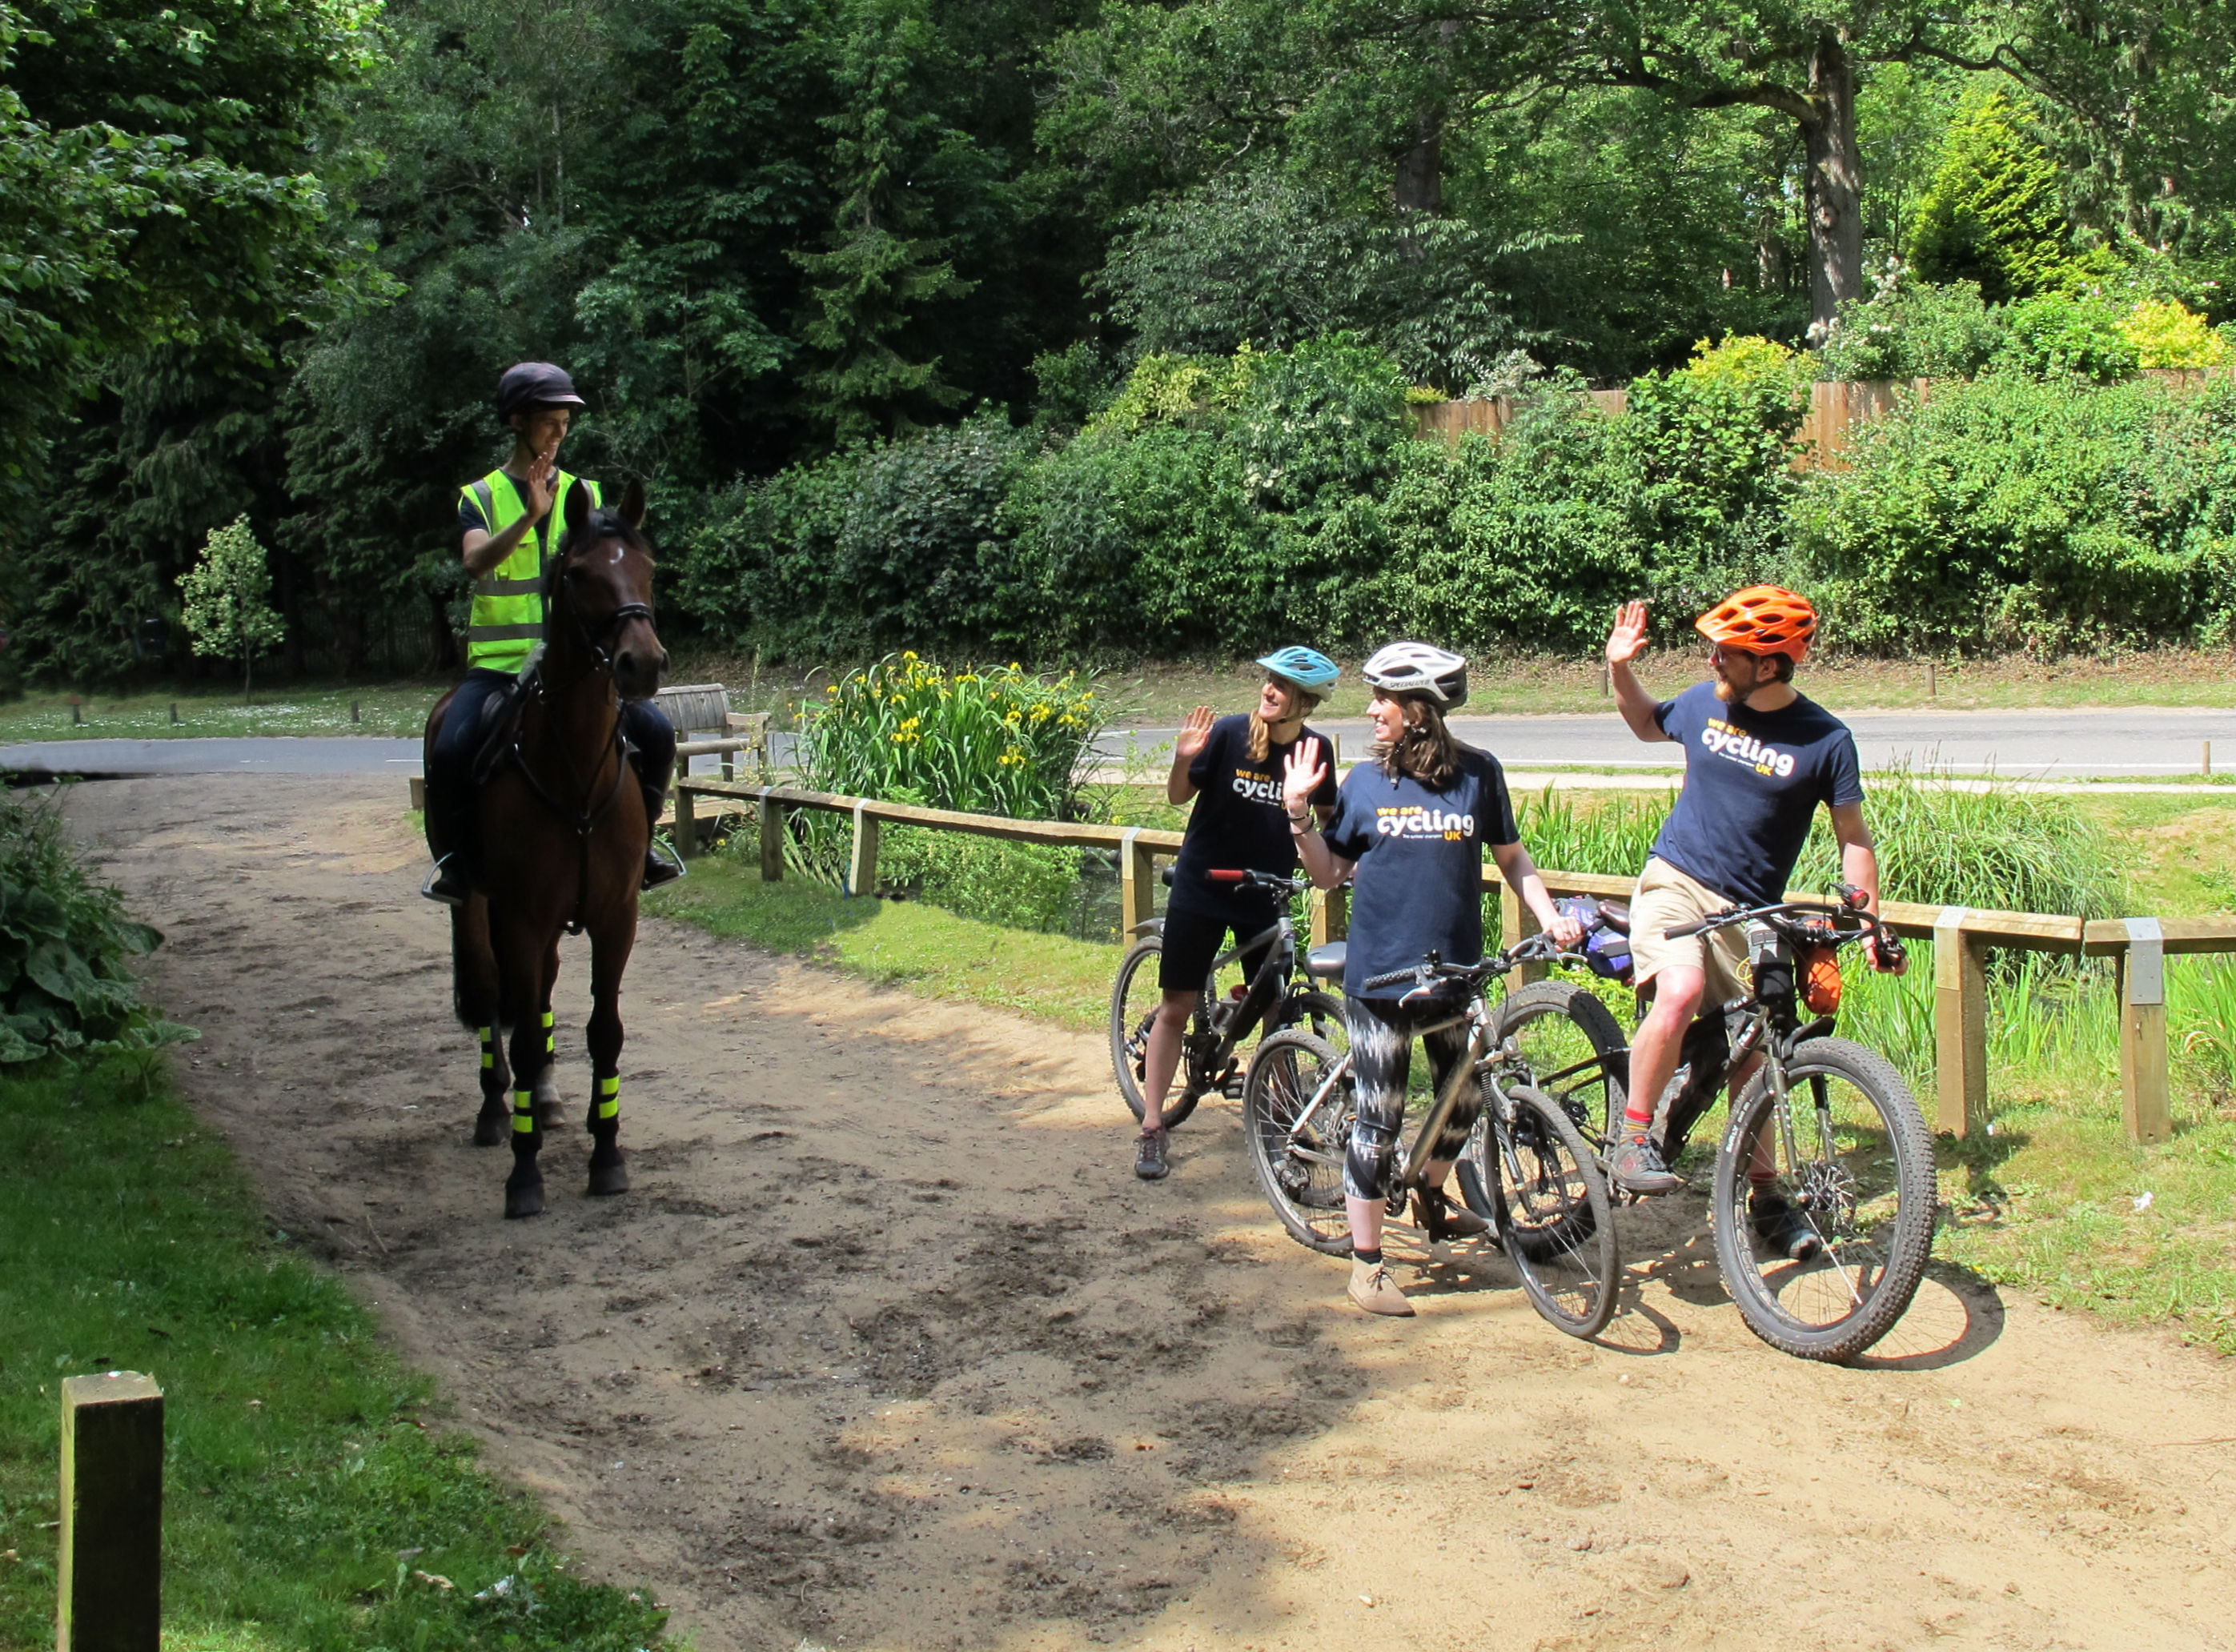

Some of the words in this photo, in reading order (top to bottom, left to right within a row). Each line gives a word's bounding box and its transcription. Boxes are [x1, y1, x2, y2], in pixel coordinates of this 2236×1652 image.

[1708, 718, 1726, 730] we
[1725, 724, 1747, 738] are
[1701, 727, 1795, 777] cycling
[1235, 768, 1252, 779] we
[1253, 772, 1271, 782] are
[1755, 763, 1773, 776] UK
[1232, 777, 1283, 800] cycli
[1376, 807, 1398, 816] we
[1399, 806, 1423, 815] are
[1377, 809, 1475, 836] cycling
[1443, 831, 1462, 841] UK
